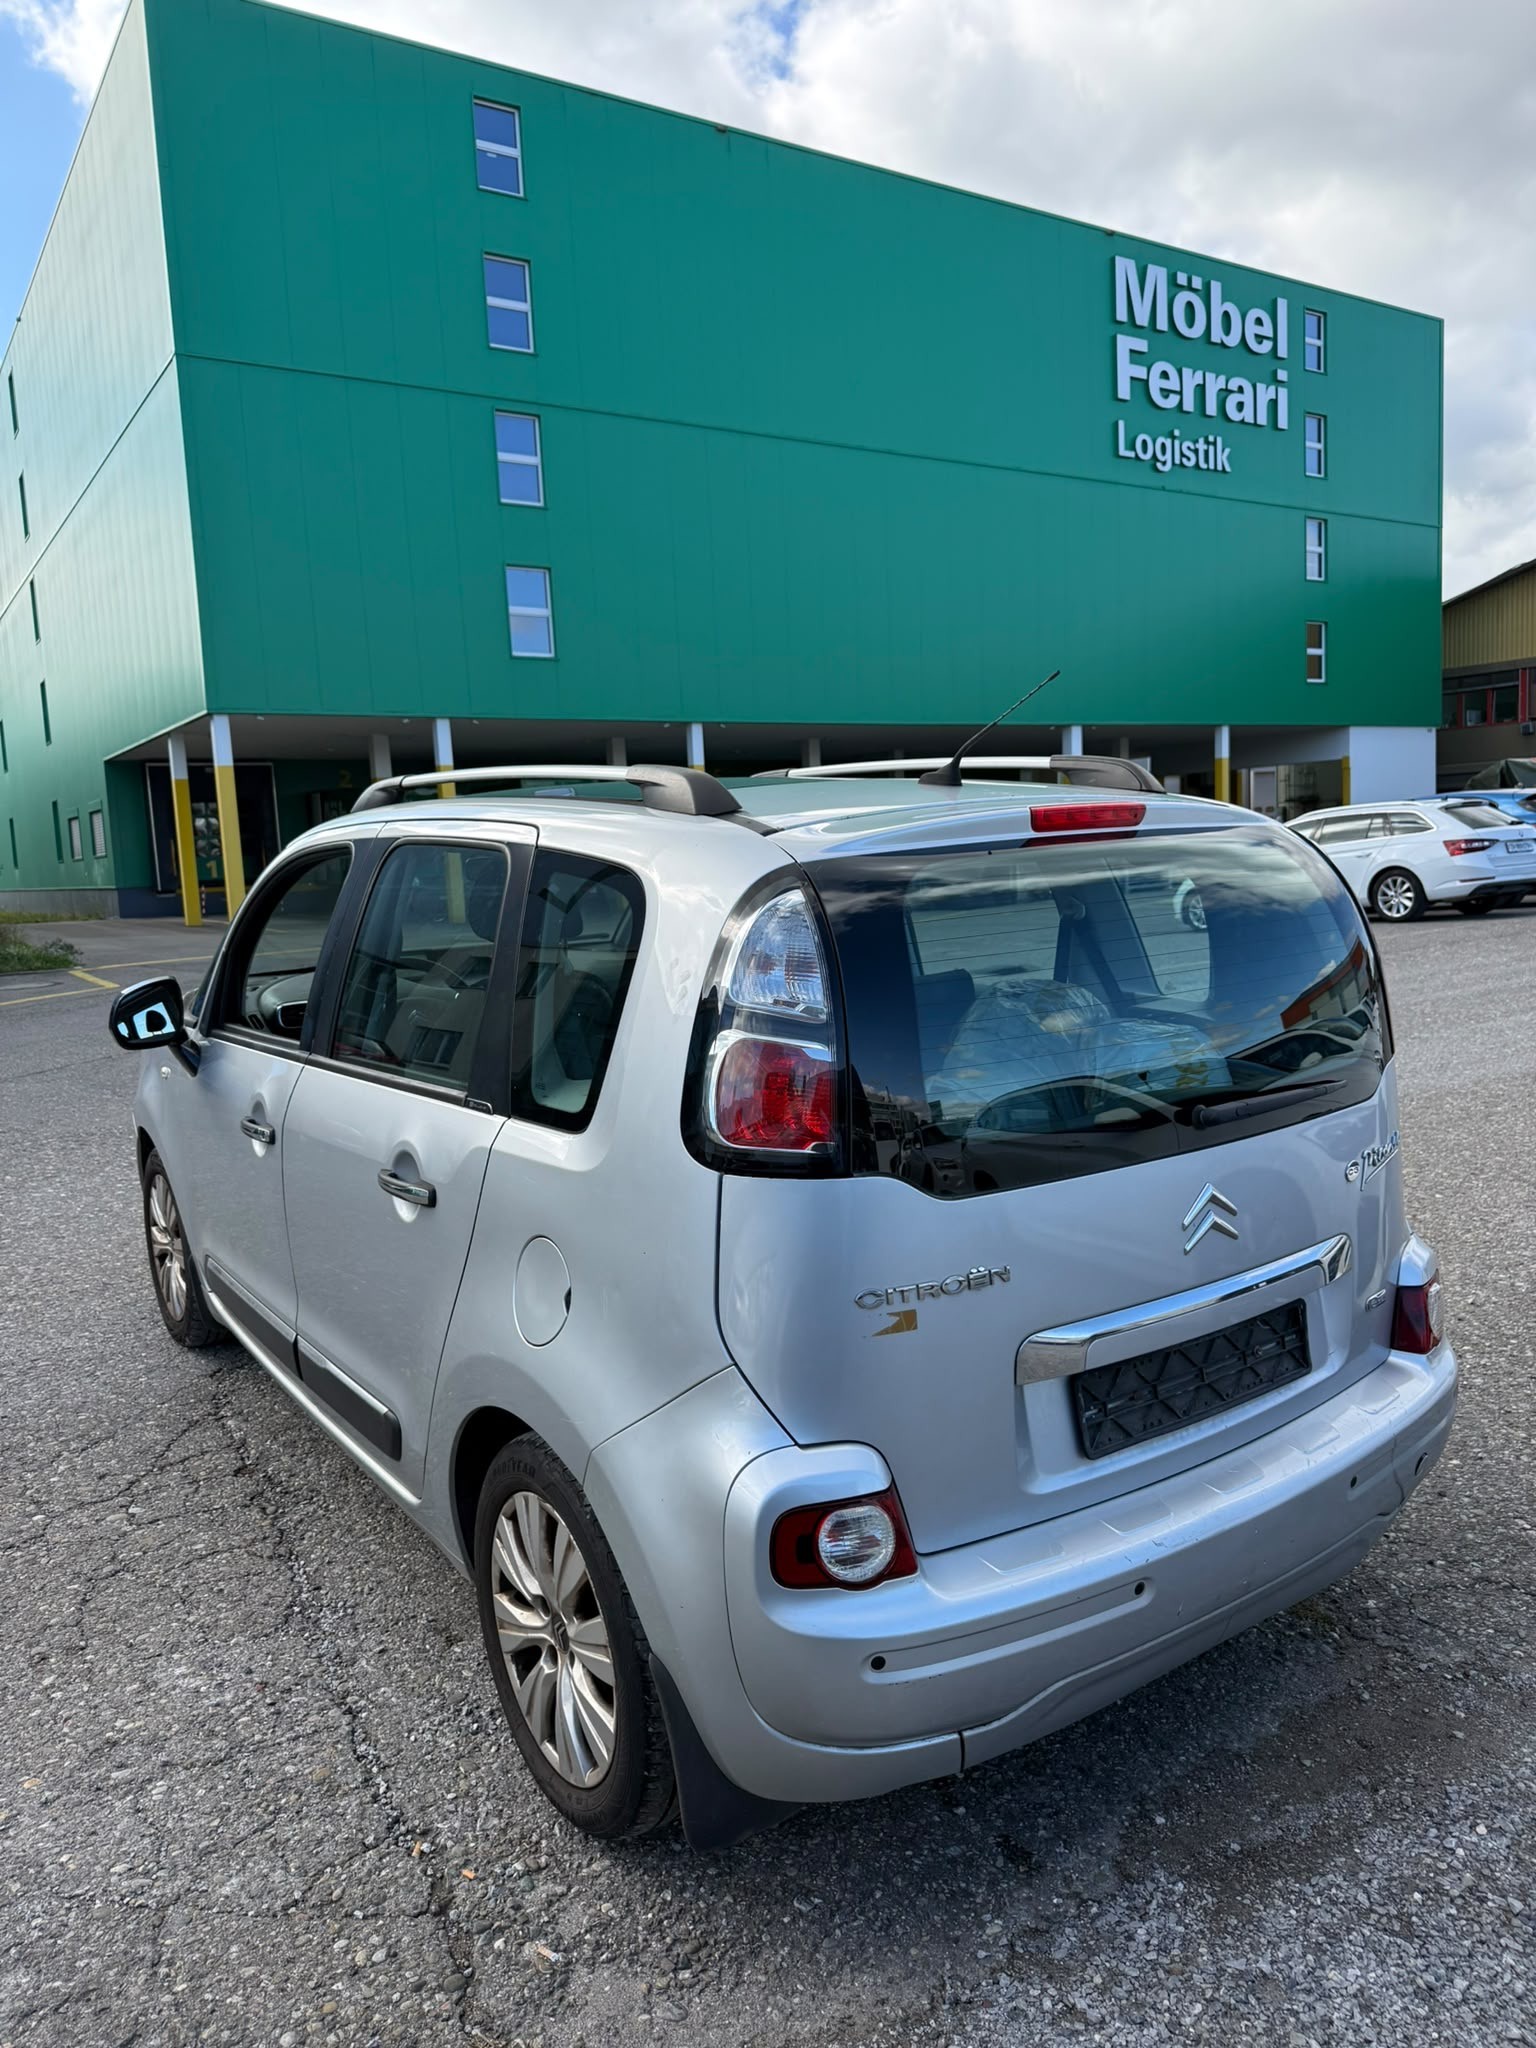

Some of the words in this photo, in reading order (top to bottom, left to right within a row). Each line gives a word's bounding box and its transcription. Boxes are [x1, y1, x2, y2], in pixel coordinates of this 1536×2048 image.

[1114, 254, 1289, 360] Möbel
[1115, 333, 1289, 431] Ferrari
[1117, 418, 1232, 473] Logistik
[205, 860, 218, 879] 1
[854, 1264, 1011, 1310] CITROËN
